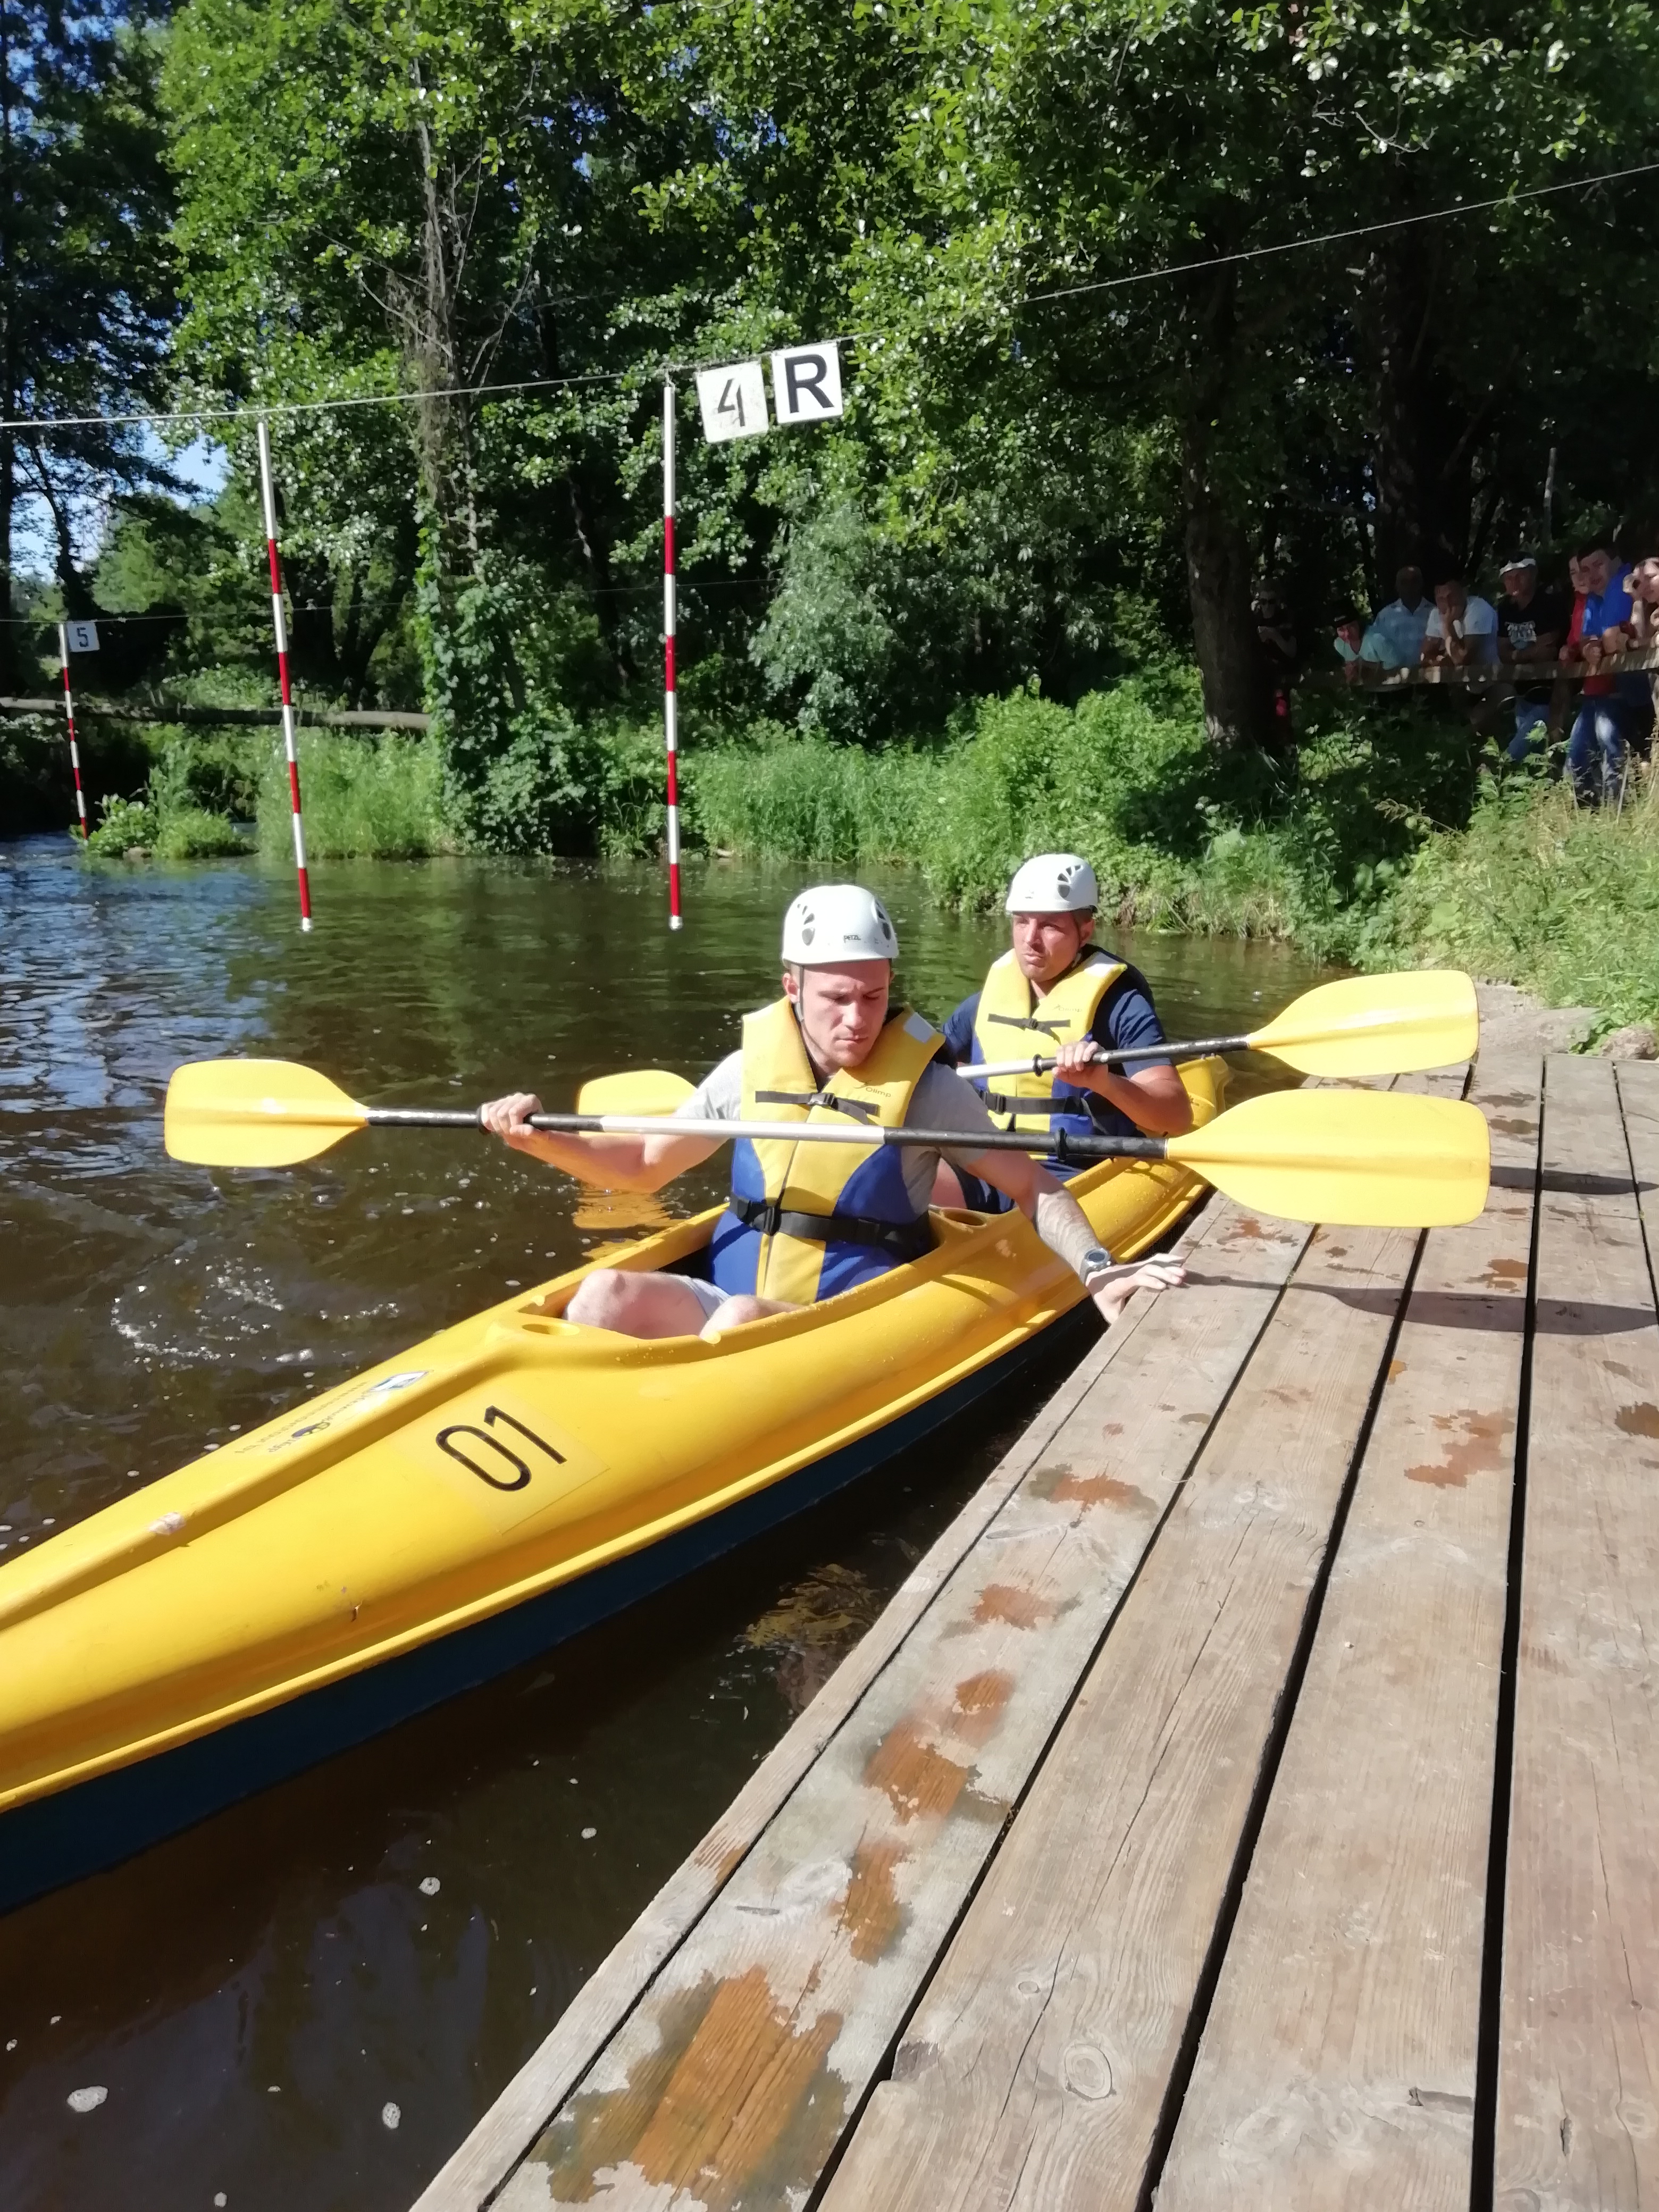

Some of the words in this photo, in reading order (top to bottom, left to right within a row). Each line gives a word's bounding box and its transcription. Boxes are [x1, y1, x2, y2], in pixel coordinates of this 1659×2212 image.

[717, 378, 745, 427] 4
[784, 353, 835, 414] R
[77, 626, 89, 648] 5
[866, 1087, 891, 1097] Olimp
[435, 1404, 568, 1492] 01
